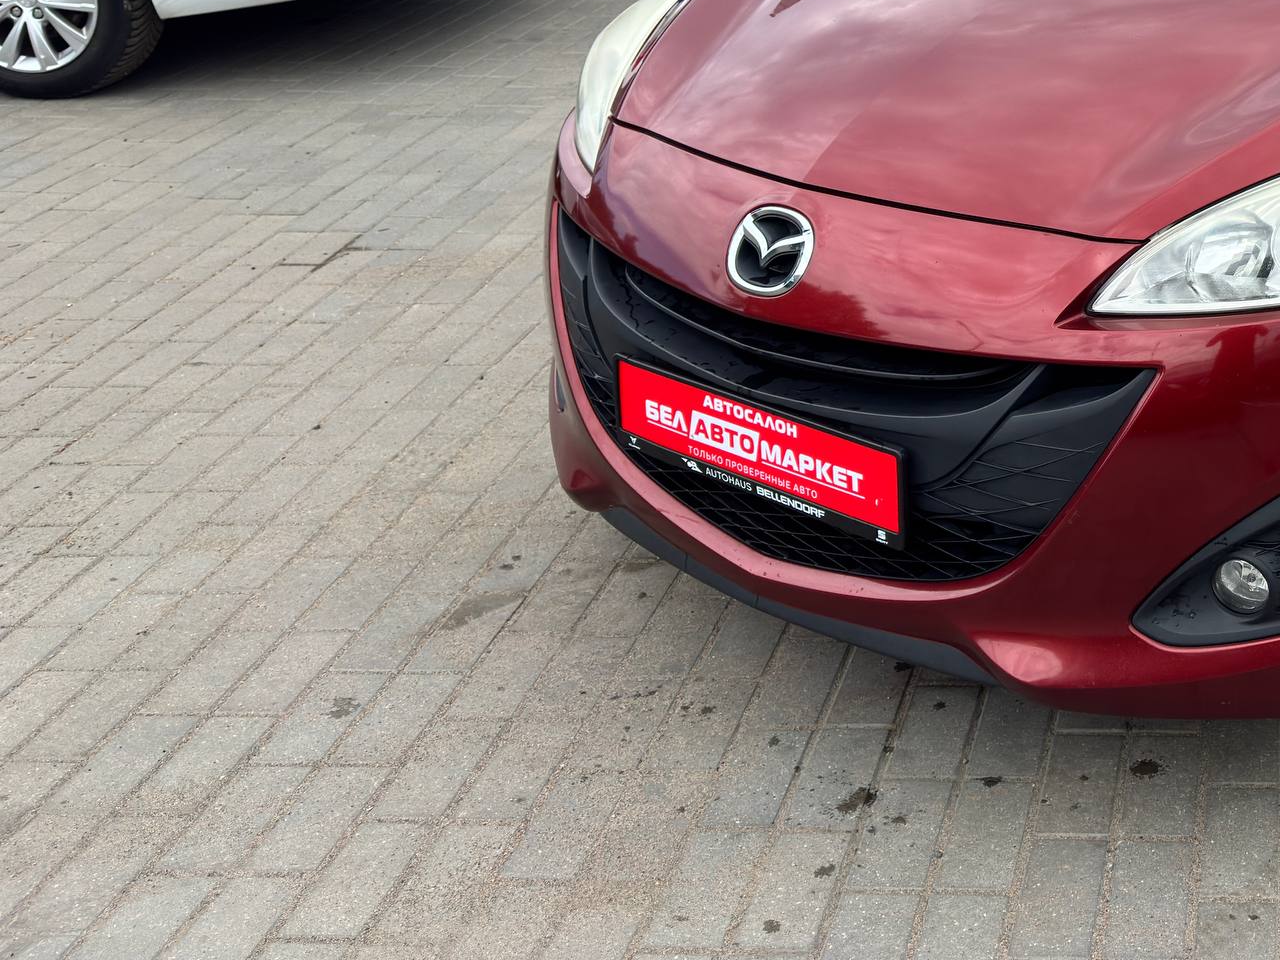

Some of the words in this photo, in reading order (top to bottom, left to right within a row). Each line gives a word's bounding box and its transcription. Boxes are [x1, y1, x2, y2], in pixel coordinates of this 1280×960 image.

[703, 395, 797, 438] АВТОСАЛОН
[645, 399, 688, 434] БЕЛ
[692, 422, 755, 455] АВТО
[761, 444, 863, 493] МАРКЕТ
[688, 445, 723, 465] ТОЛЬКО
[725, 459, 791, 490] ПРОВЕРЕННЫЕ
[793, 485, 818, 499] АВТО
[705, 467, 752, 492] AUTOHAUS
[756, 485, 825, 518] BELLENDORF
